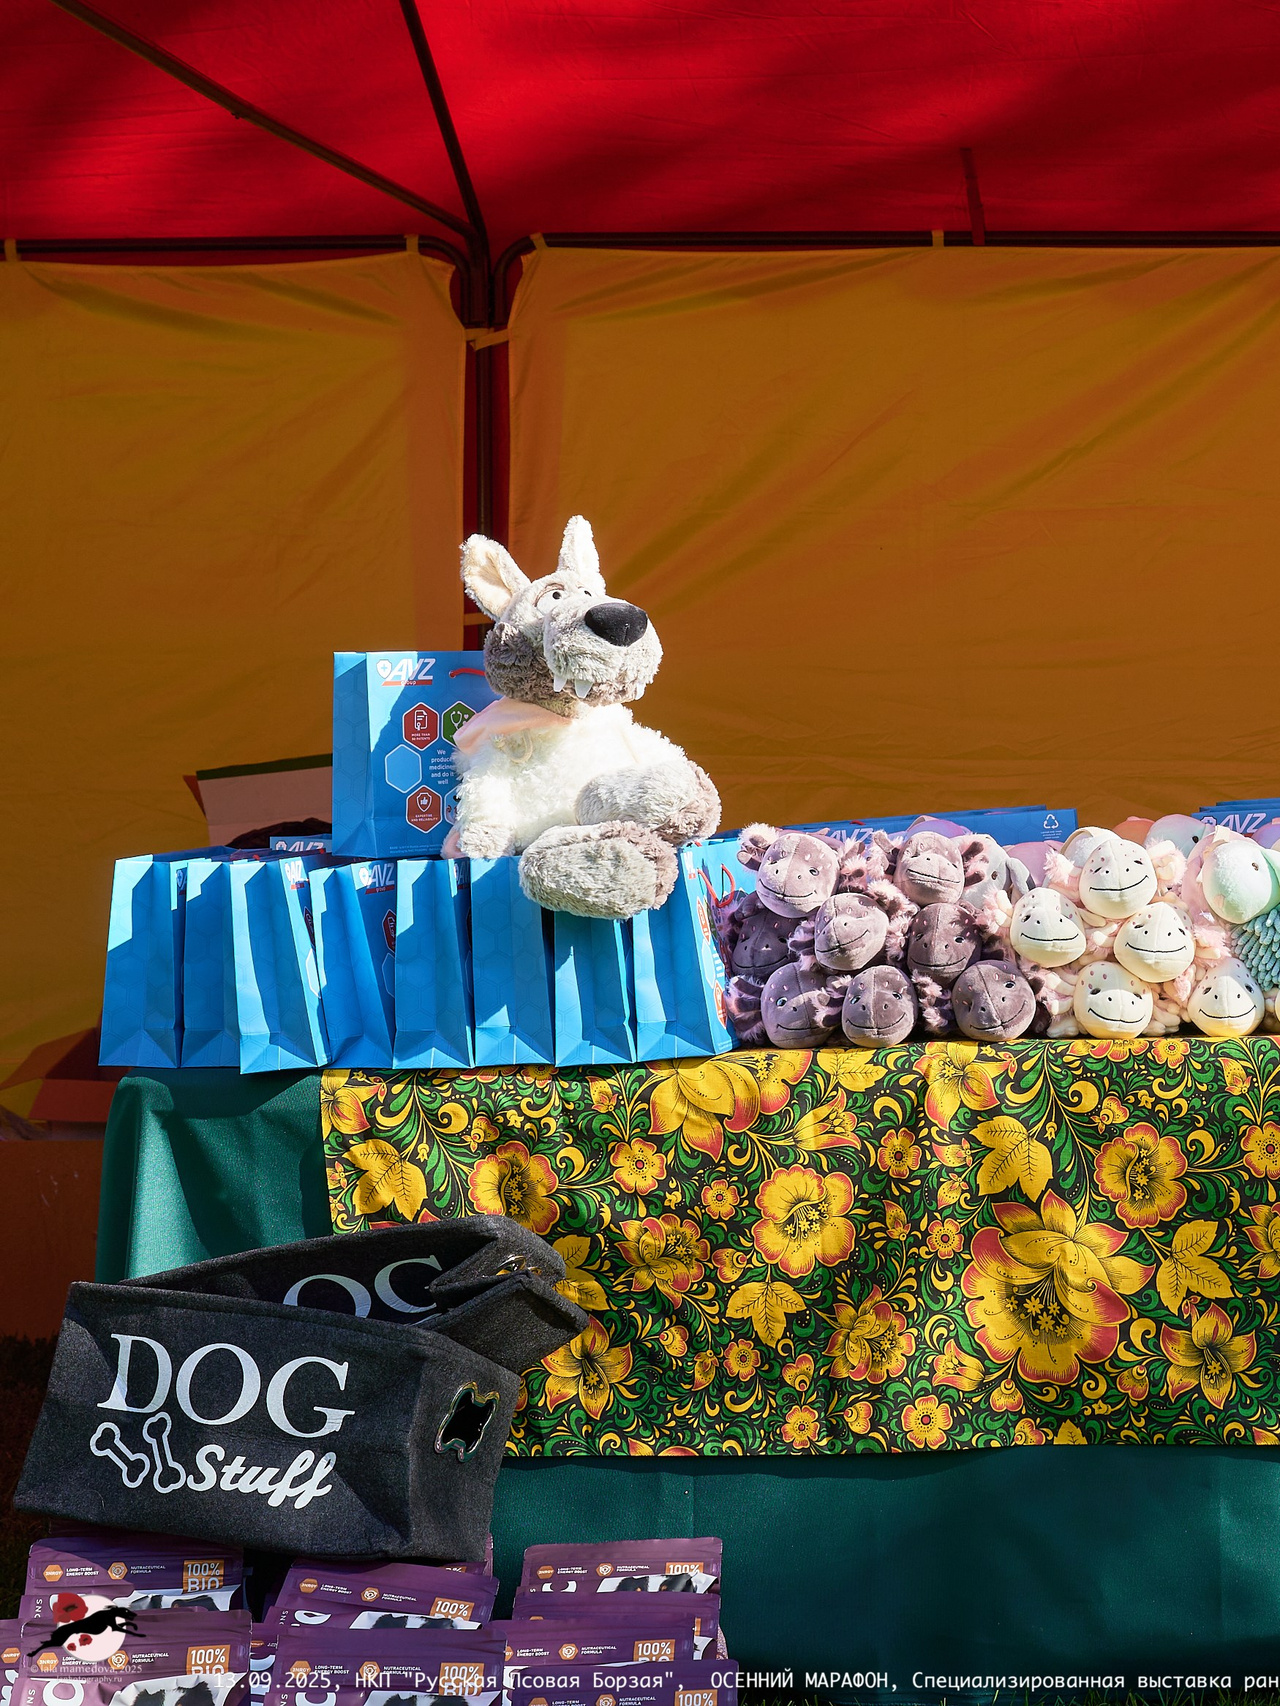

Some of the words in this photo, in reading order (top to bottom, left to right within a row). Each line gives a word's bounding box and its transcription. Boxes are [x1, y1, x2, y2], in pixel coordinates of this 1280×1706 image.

[386, 658, 436, 681] AVZ
[1220, 813, 1266, 833] AVZ
[97, 1333, 355, 1438] DOG
[186, 1444, 337, 1509] Stuff
[187, 1562, 220, 1576] 100%
[669, 1564, 700, 1575] 100%
[187, 1577, 220, 1592] BIO
[435, 1600, 470, 1617] 100%
[637, 1642, 671, 1656] 100%
[191, 1649, 226, 1665] 100%
[444, 1665, 481, 1680] 100%
[679, 1693, 713, 1706] 100%
